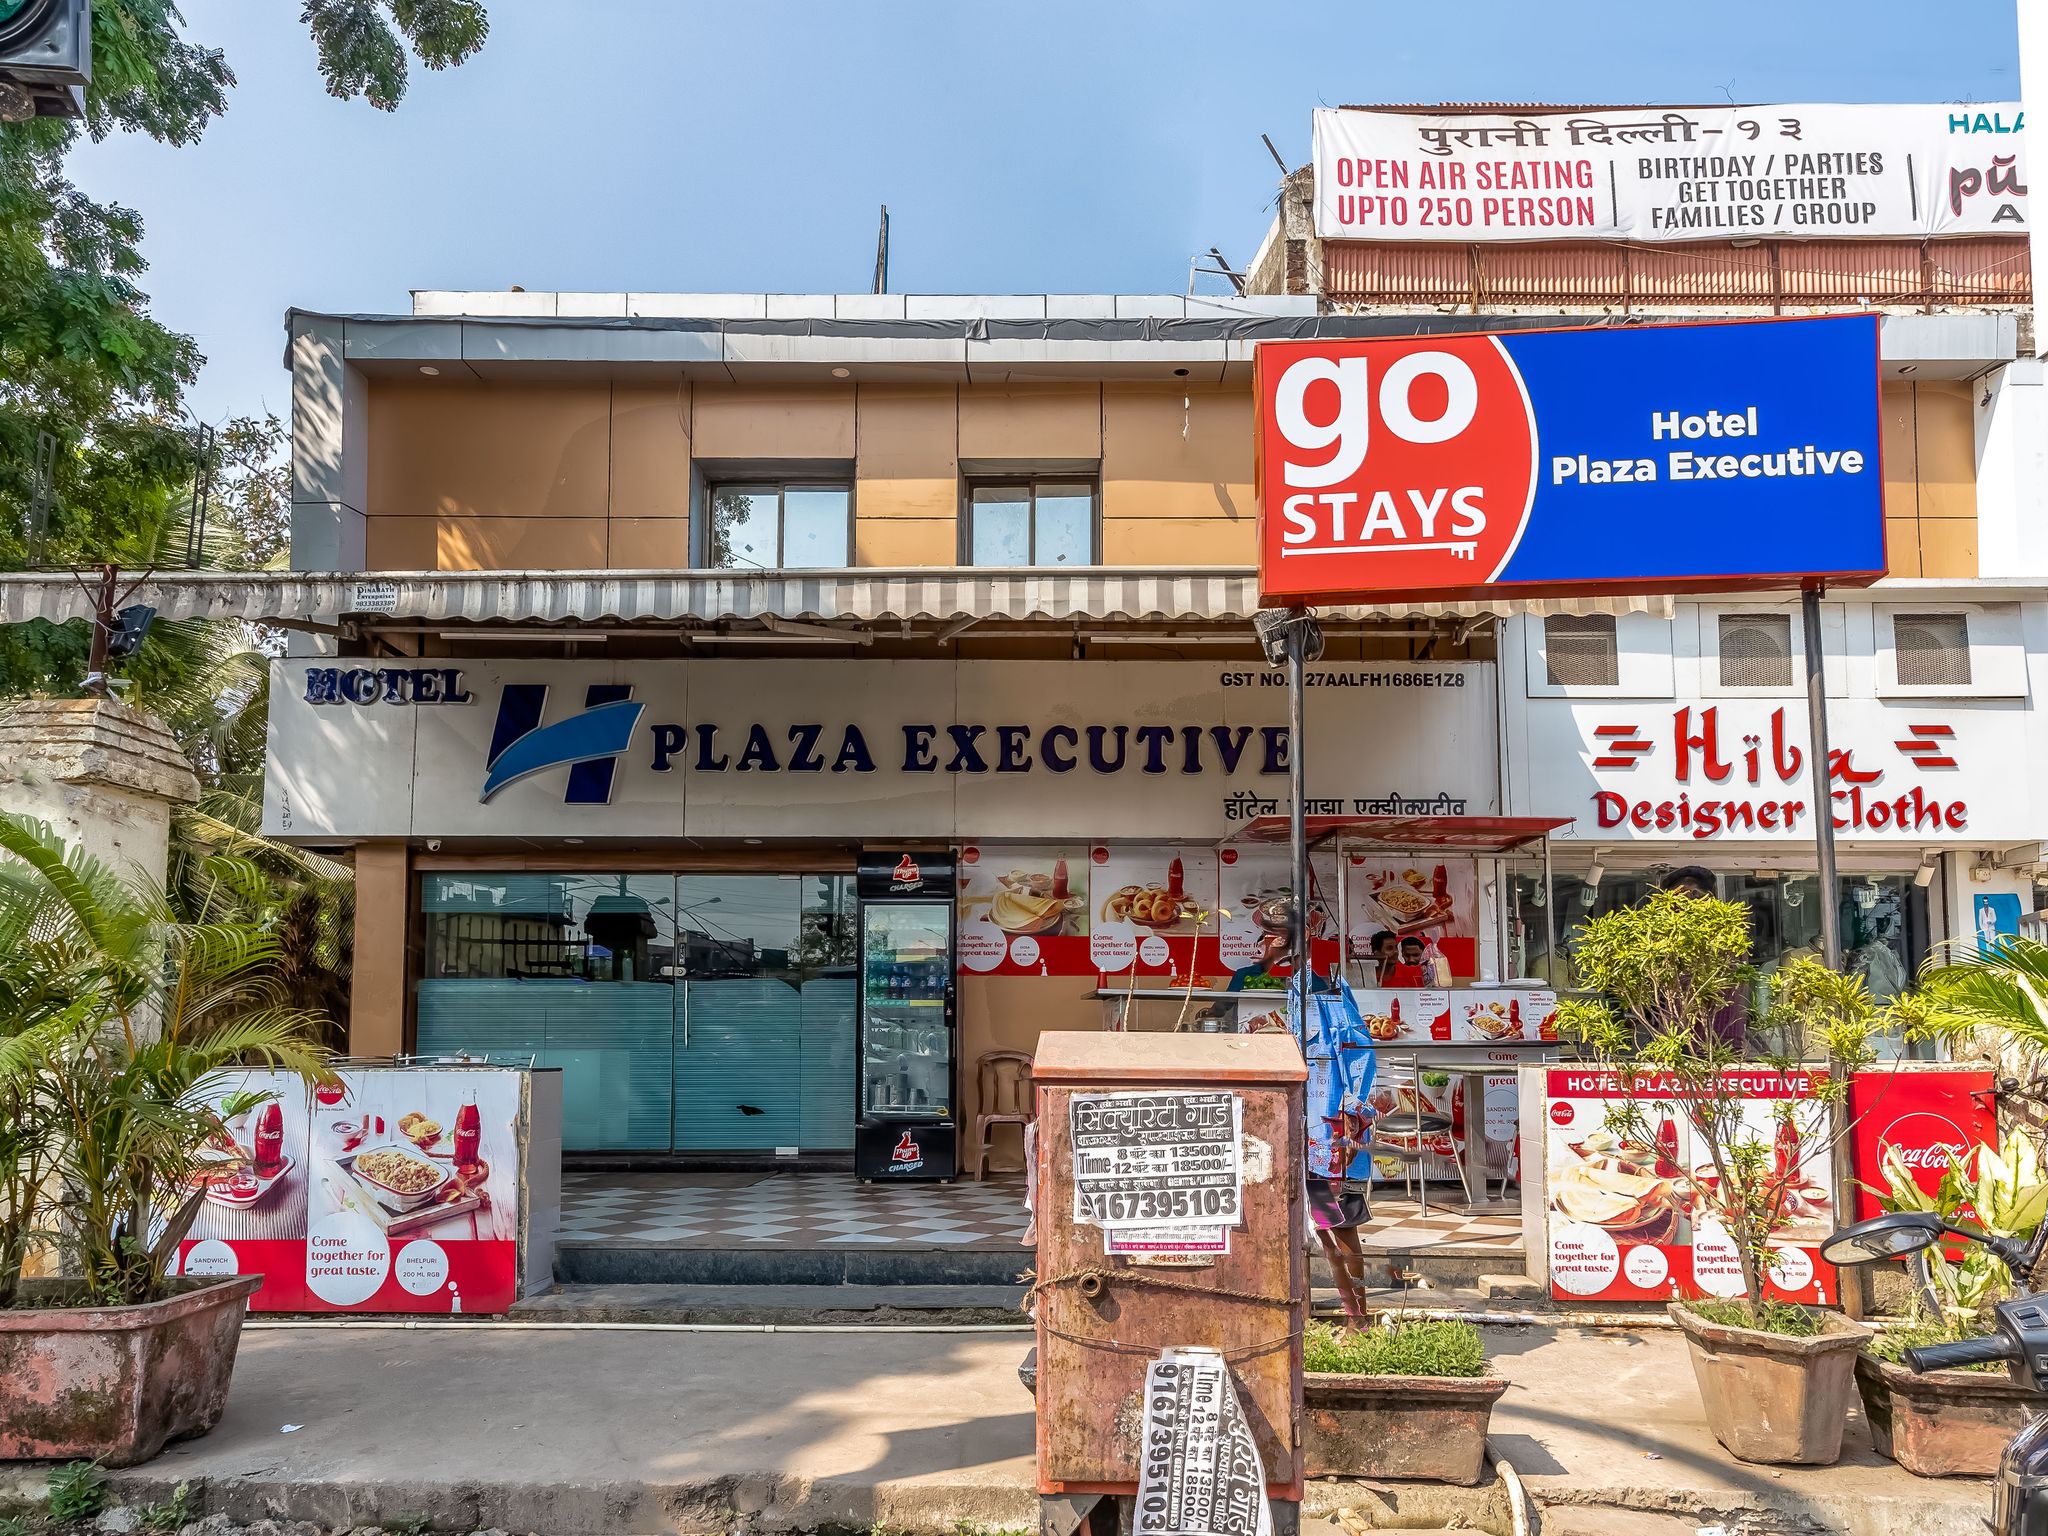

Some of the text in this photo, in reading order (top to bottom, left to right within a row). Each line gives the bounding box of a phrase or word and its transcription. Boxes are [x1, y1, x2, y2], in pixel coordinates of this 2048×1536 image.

[1418, 119, 1551, 156] पुरानी
[1637, 154, 1757, 180] BIRTHDAY
[1785, 150, 1885, 177] PARTIES
[1337, 158, 1594, 190] OPEN AIR SEATING
[1678, 177, 1848, 203] GET TOGETHER
[1337, 196, 1595, 228] UPTO 250 PERSON
[1651, 203, 1766, 230] FAMILIES
[1793, 202, 1878, 226] GROUP
[1275, 350, 1479, 489] go
[1652, 406, 1758, 441] Hotel
[1552, 444, 1865, 485] Plaza Executive
[1282, 486, 1487, 545] STAYS
[303, 668, 474, 705] HOTEL
[1221, 672, 1465, 688] GST NO. 27AALFH1686E1Z8
[651, 723, 1293, 776] PLAZA EXECUTIVE
[1223, 791, 1279, 820] हॉटेल
[1590, 790, 1805, 839] Designer
[1487, 1051, 1518, 1061] Come
[1488, 1077, 1517, 1087] great
[1568, 1077, 1629, 1092] HOTEL
[1184, 1095, 1232, 1128] गार्ड
[258, 1130, 280, 1140] Coca-Cola
[456, 1128, 476, 1137] Coca-Cola
[1117, 1149, 1128, 1160] 8
[1169, 1145, 1232, 1158] 13500/-
[888, 1161, 924, 1173] CHARGED
[1078, 1153, 1111, 1175] Time
[1171, 1158, 1233, 1172] 18500/-
[311, 1236, 347, 1247] Come
[1554, 1241, 1585, 1250] Come
[1696, 1242, 1727, 1252] Come
[311, 1250, 386, 1263] together for
[1555, 1252, 1616, 1262] together for
[311, 1266, 380, 1278] great taste.
[1555, 1265, 1613, 1273] great taste.
[1697, 1266, 1726, 1275] great
[1196, 1370, 1219, 1403] Time
[1192, 1406, 1205, 1423] 12
[1206, 1412, 1218, 1422] 8
[1141, 1364, 1179, 1530] 9167395103
[1187, 1446, 1198, 1462] का
[1201, 1446, 1212, 1463] का
[1183, 1467, 1197, 1528] 18500/-
[1195, 1468, 1213, 1528] 13500/-
